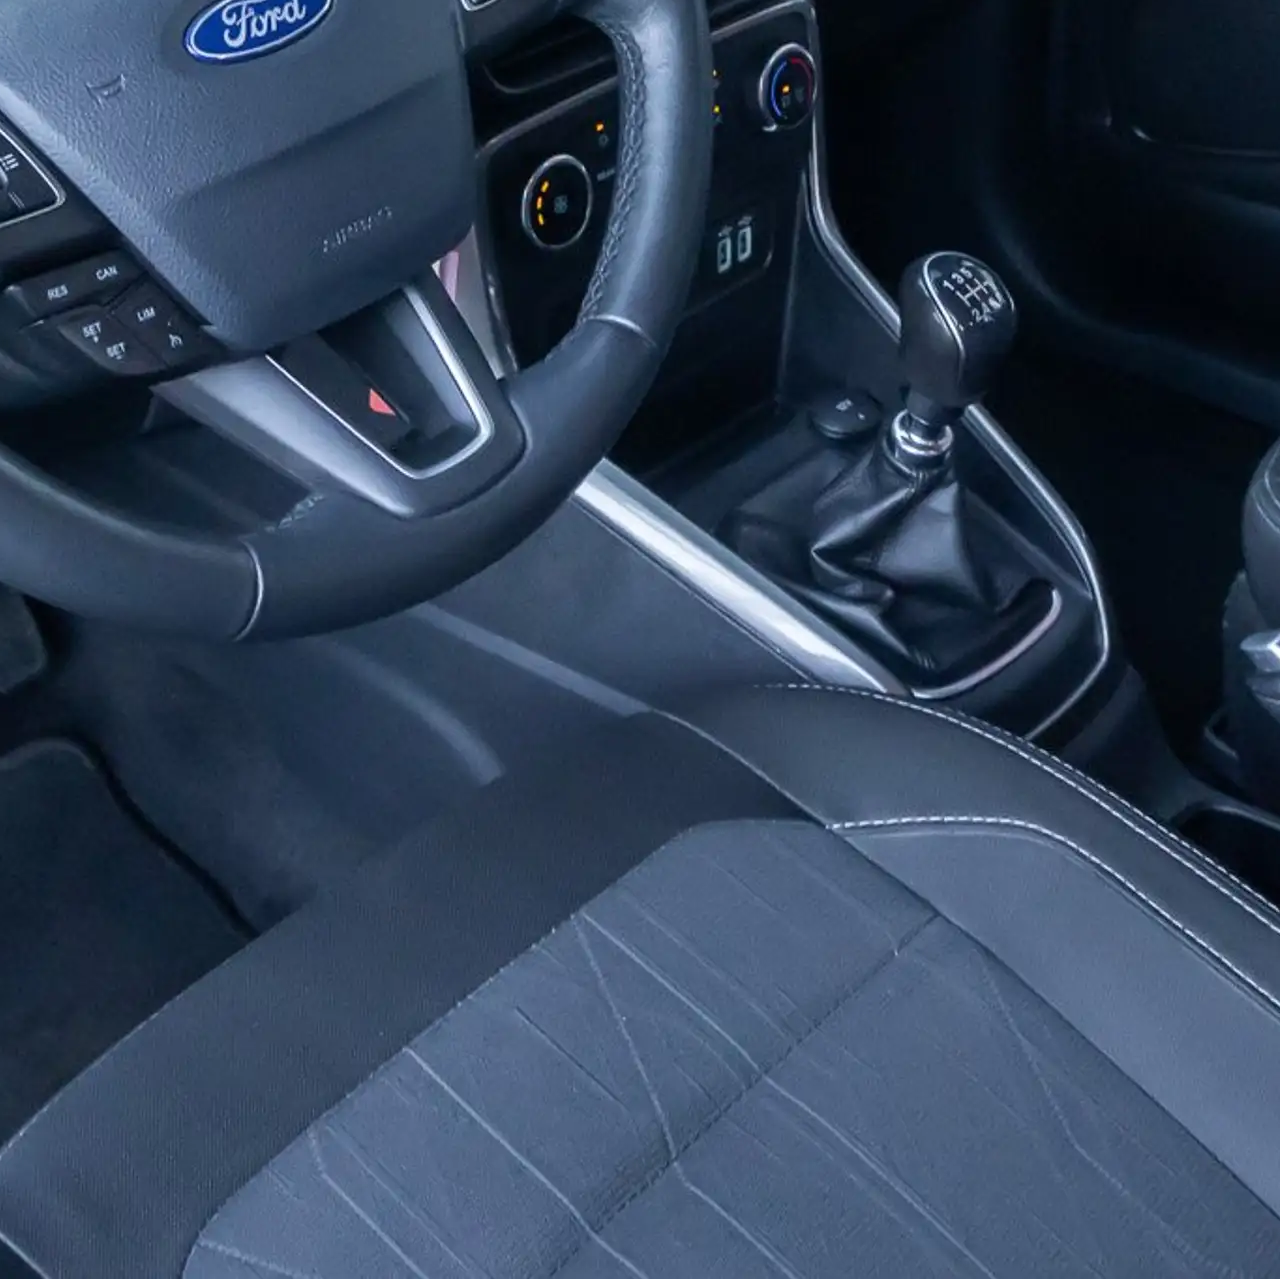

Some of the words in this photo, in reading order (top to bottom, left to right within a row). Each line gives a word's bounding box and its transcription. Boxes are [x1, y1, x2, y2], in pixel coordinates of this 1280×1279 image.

[47, 283, 69, 300] RES
[95, 265, 118, 281] CAN
[136, 306, 156, 322] LIM
[82, 321, 102, 338] SET
[105, 341, 127, 358] SET
